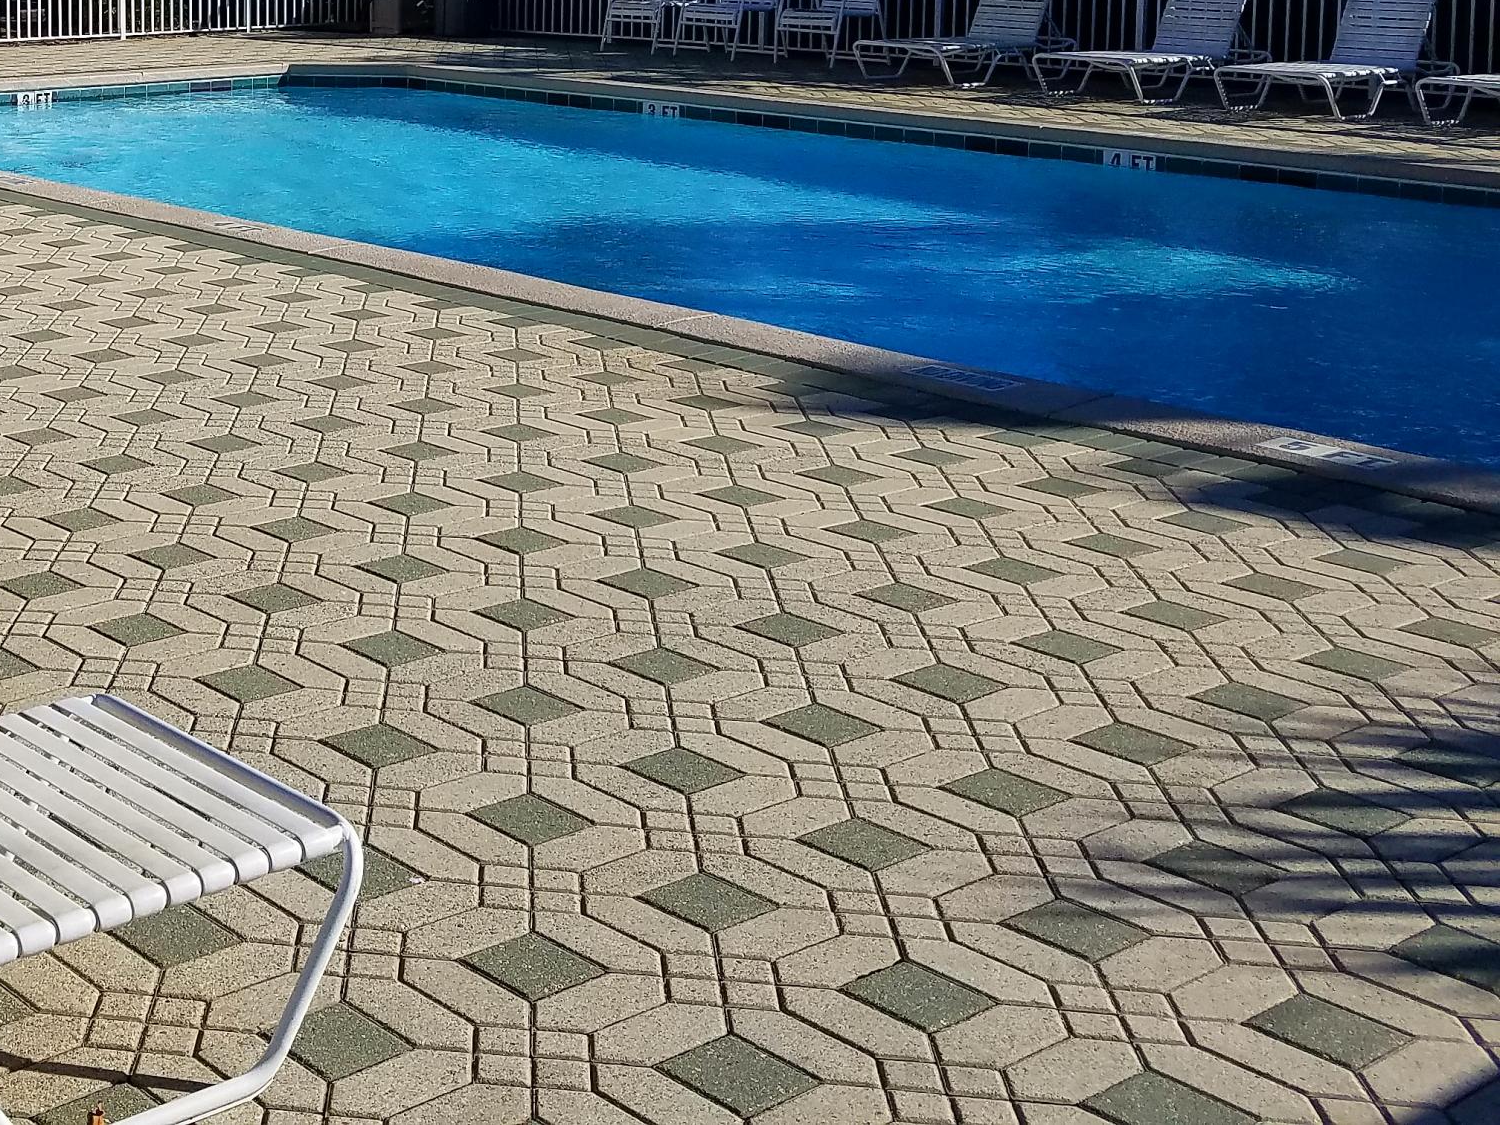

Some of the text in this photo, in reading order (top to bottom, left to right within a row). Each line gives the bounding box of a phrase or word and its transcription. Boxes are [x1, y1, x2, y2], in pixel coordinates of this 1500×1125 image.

[661, 105, 678, 117] FT
[1131, 154, 1154, 170] FT
[1279, 441, 1392, 468] 5 FT
